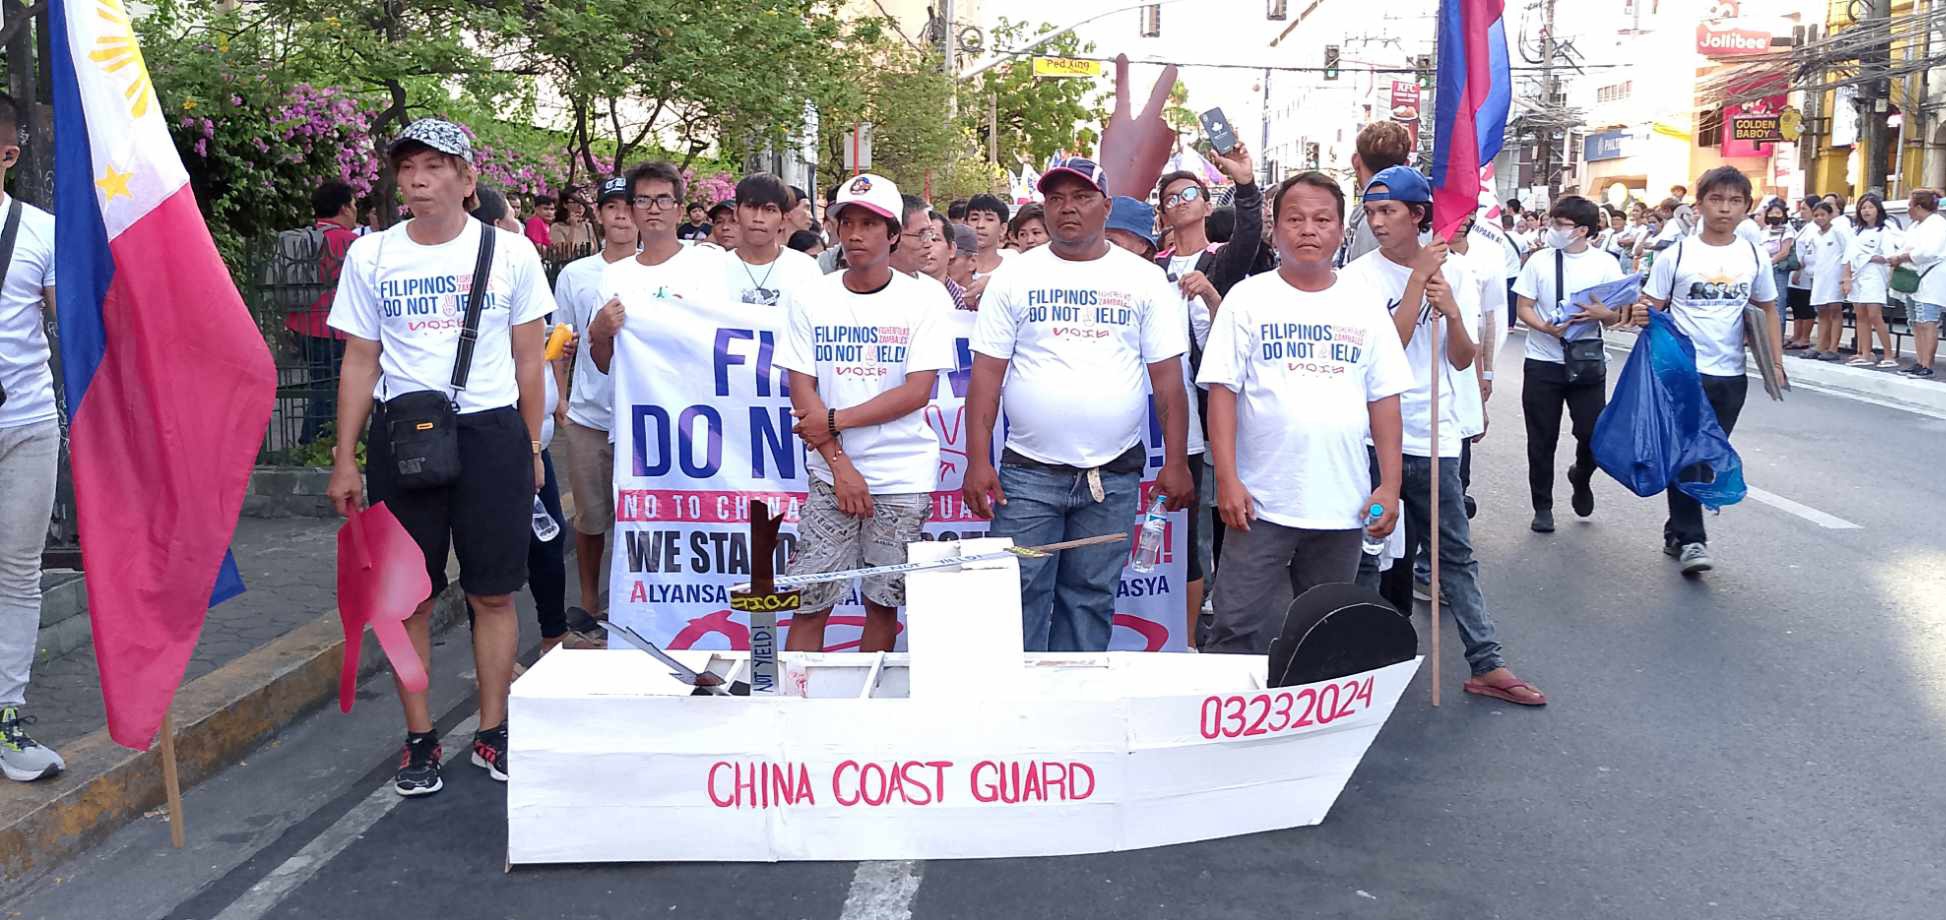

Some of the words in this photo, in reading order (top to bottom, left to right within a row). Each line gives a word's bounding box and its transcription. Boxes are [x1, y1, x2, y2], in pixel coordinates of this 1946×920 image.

[1700, 32, 1767, 48] Jollibee
[1046, 59, 1066, 69] Ped
[1397, 82, 1416, 93] KFC
[1736, 120, 1776, 129] GOLDEN
[1736, 129, 1770, 138] BABOY
[380, 275, 457, 298] FILIPINOS
[383, 299, 402, 317] DO
[407, 296, 439, 315] NOT
[1028, 289, 1098, 306] FILIPINOS
[1029, 306, 1047, 323] DO
[1052, 306, 1080, 322] NOT
[814, 325, 878, 343] FILIPINOS
[1260, 323, 1333, 341] FILIPINOS
[815, 345, 833, 362] DO
[835, 345, 864, 362] NOT
[1262, 341, 1282, 360] DO
[1286, 341, 1315, 359] NOT
[631, 404, 723, 479] DO
[623, 493, 658, 519] NO
[673, 495, 701, 520] TO
[717, 495, 803, 522] CHNA
[624, 530, 681, 574] WE
[689, 531, 798, 576] STAD
[629, 580, 728, 605] ALYANSA
[751, 625, 774, 667] YIELD!
[752, 671, 774, 693] NOT
[1200, 675, 1375, 740] 03232024
[706, 761, 816, 810] CHINA
[832, 759, 954, 807] COAST
[970, 759, 1096, 804] GUARD
